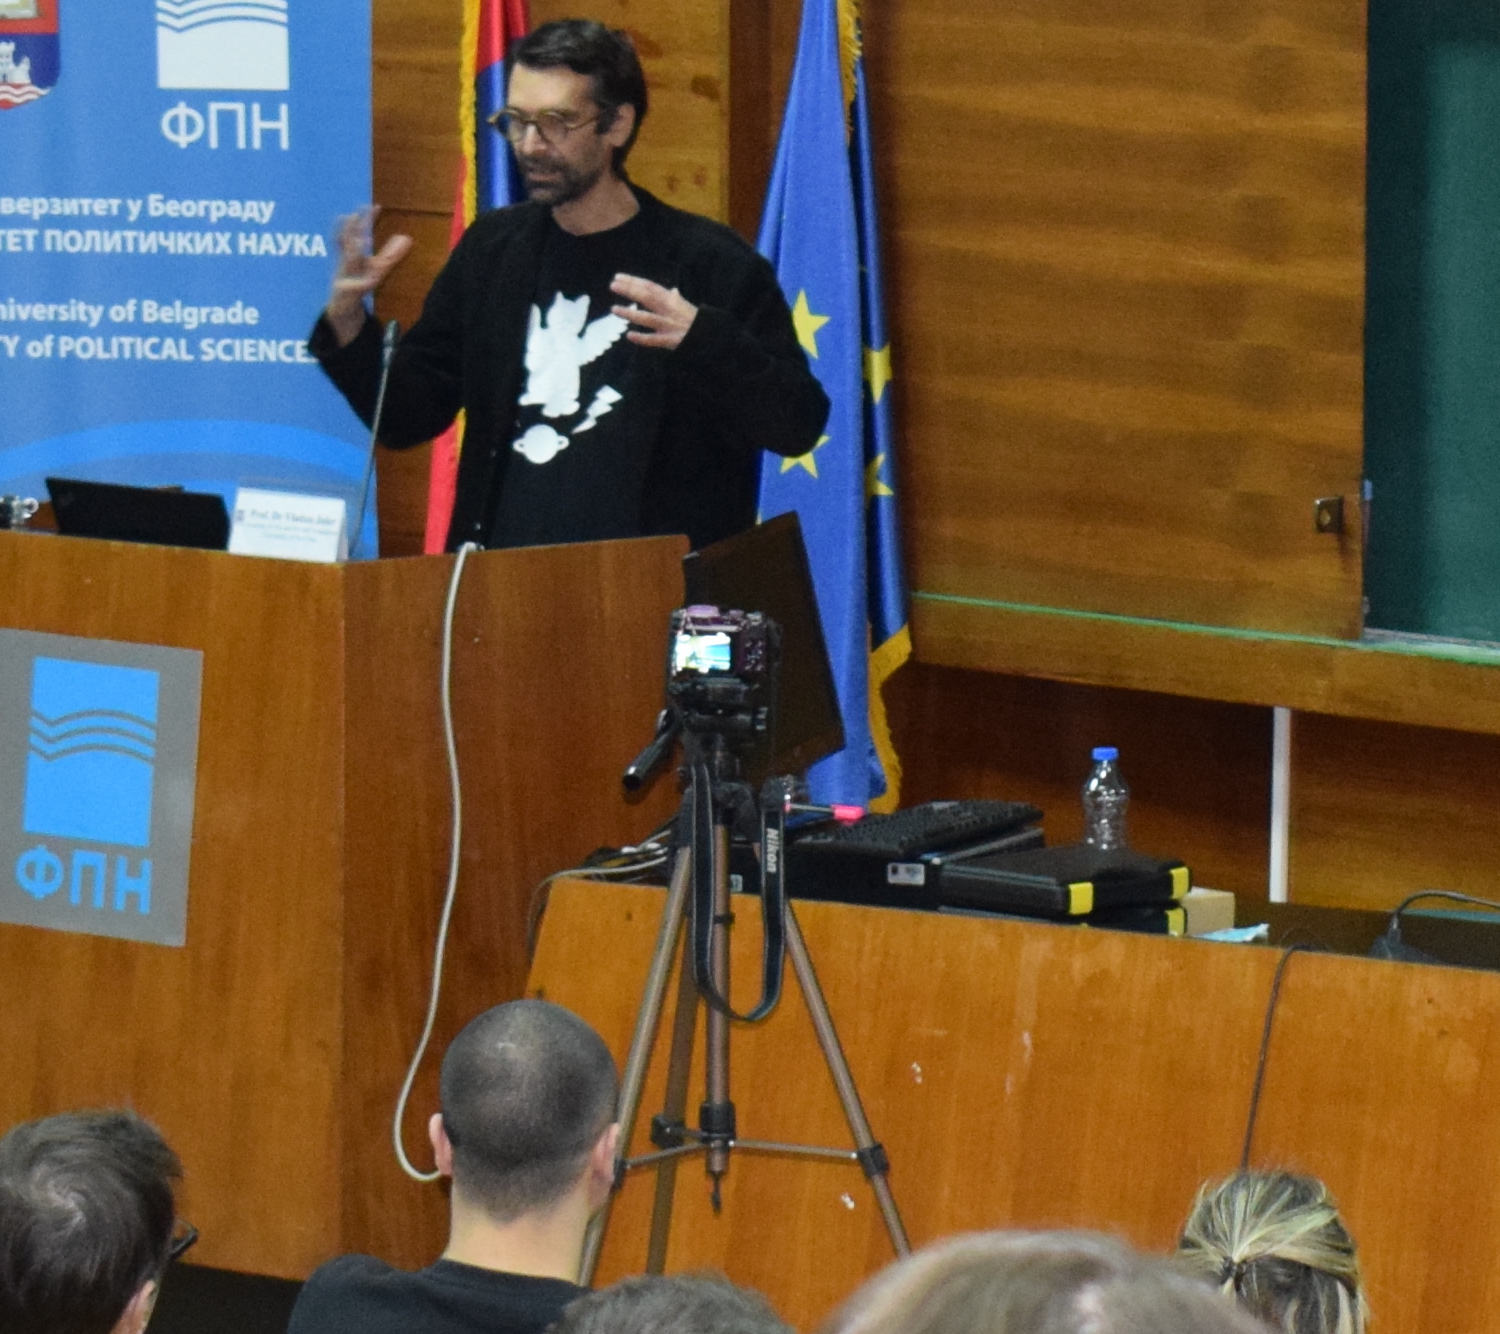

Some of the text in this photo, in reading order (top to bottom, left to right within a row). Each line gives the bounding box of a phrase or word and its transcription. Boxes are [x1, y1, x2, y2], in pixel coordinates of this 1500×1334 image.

[160, 101, 290, 151] ФПН
[126, 198, 143, 222] у
[148, 193, 276, 224] Београду
[44, 229, 232, 255] ПОЛИТИЧКИХ
[238, 233, 328, 257] НАУКА
[109, 298, 137, 322] of
[142, 299, 260, 330] Belgrade
[26, 334, 54, 358] of
[59, 335, 195, 361] POLITICAL
[200, 338, 320, 363] SCIENCE
[766, 828, 779, 873] Nikon
[15, 844, 153, 915] ФПН
